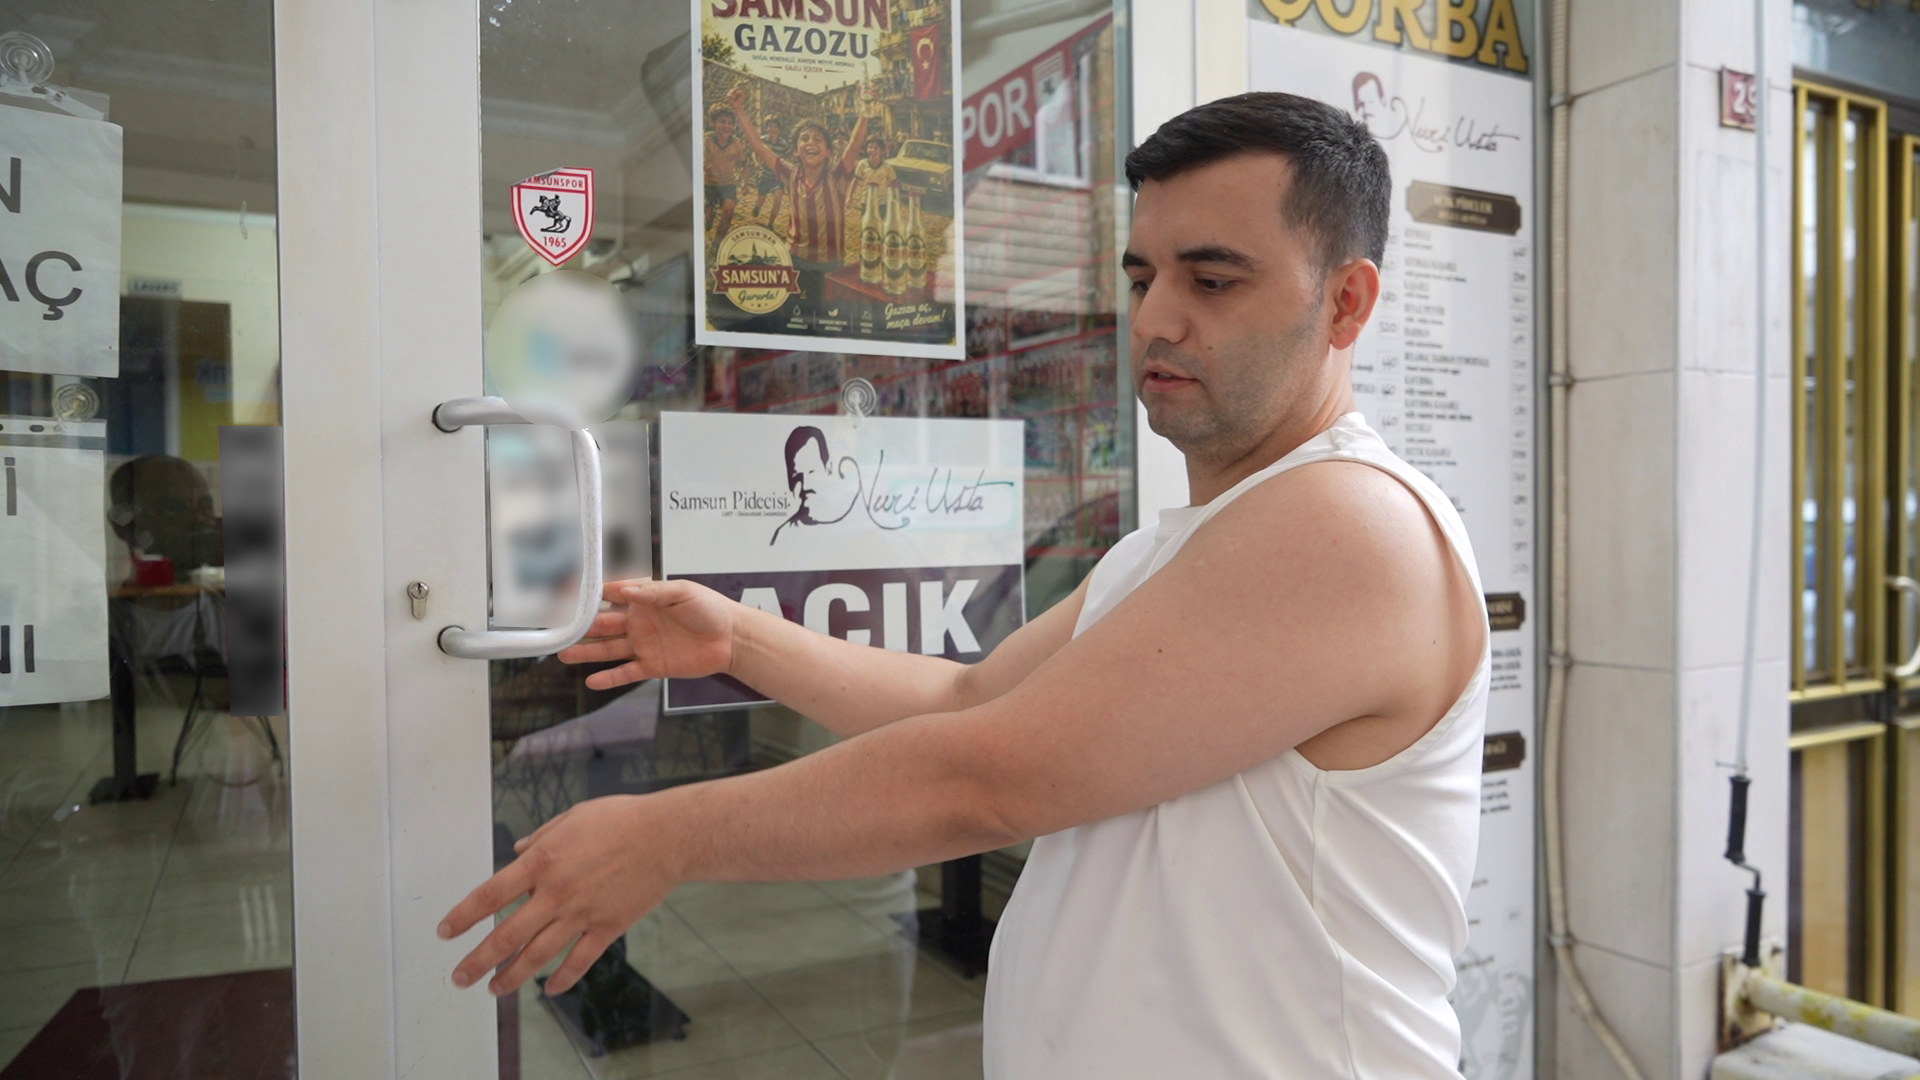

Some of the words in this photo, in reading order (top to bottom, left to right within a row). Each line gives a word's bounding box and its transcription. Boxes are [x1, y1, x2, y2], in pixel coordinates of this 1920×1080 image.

[734, 24, 869, 59] GAZOZU
[543, 236, 567, 248] 1965
[722, 269, 790, 284] SAMSUN'A
[738, 290, 779, 305] Gururla!
[912, 308, 947, 326] devam!
[669, 490, 727, 510] Samsun
[838, 449, 920, 530] Nuri
[926, 467, 1014, 514] Usta
